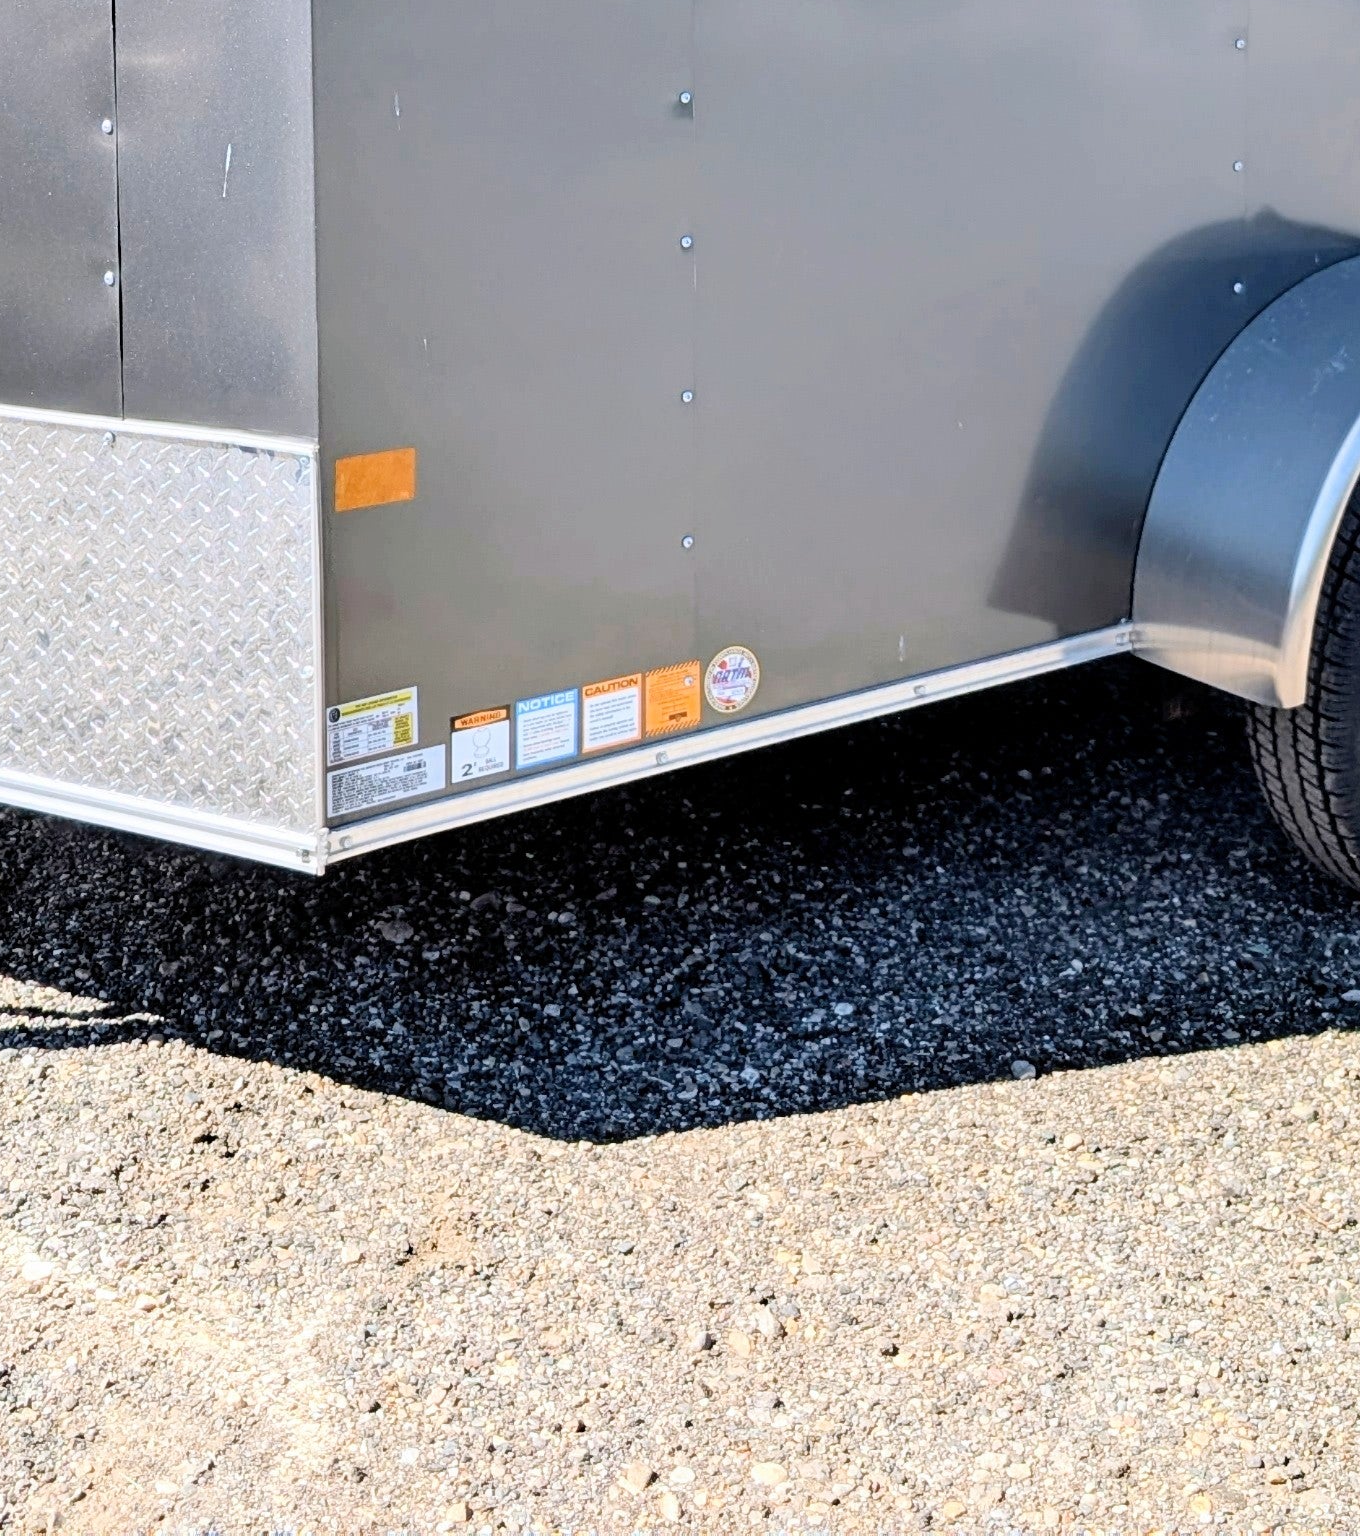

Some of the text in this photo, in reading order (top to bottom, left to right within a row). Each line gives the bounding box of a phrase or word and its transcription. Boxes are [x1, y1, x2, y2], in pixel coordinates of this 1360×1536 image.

[585, 677, 638, 696] CAUTION
[518, 691, 575, 712] NOTICE
[460, 712, 501, 726] WARNING
